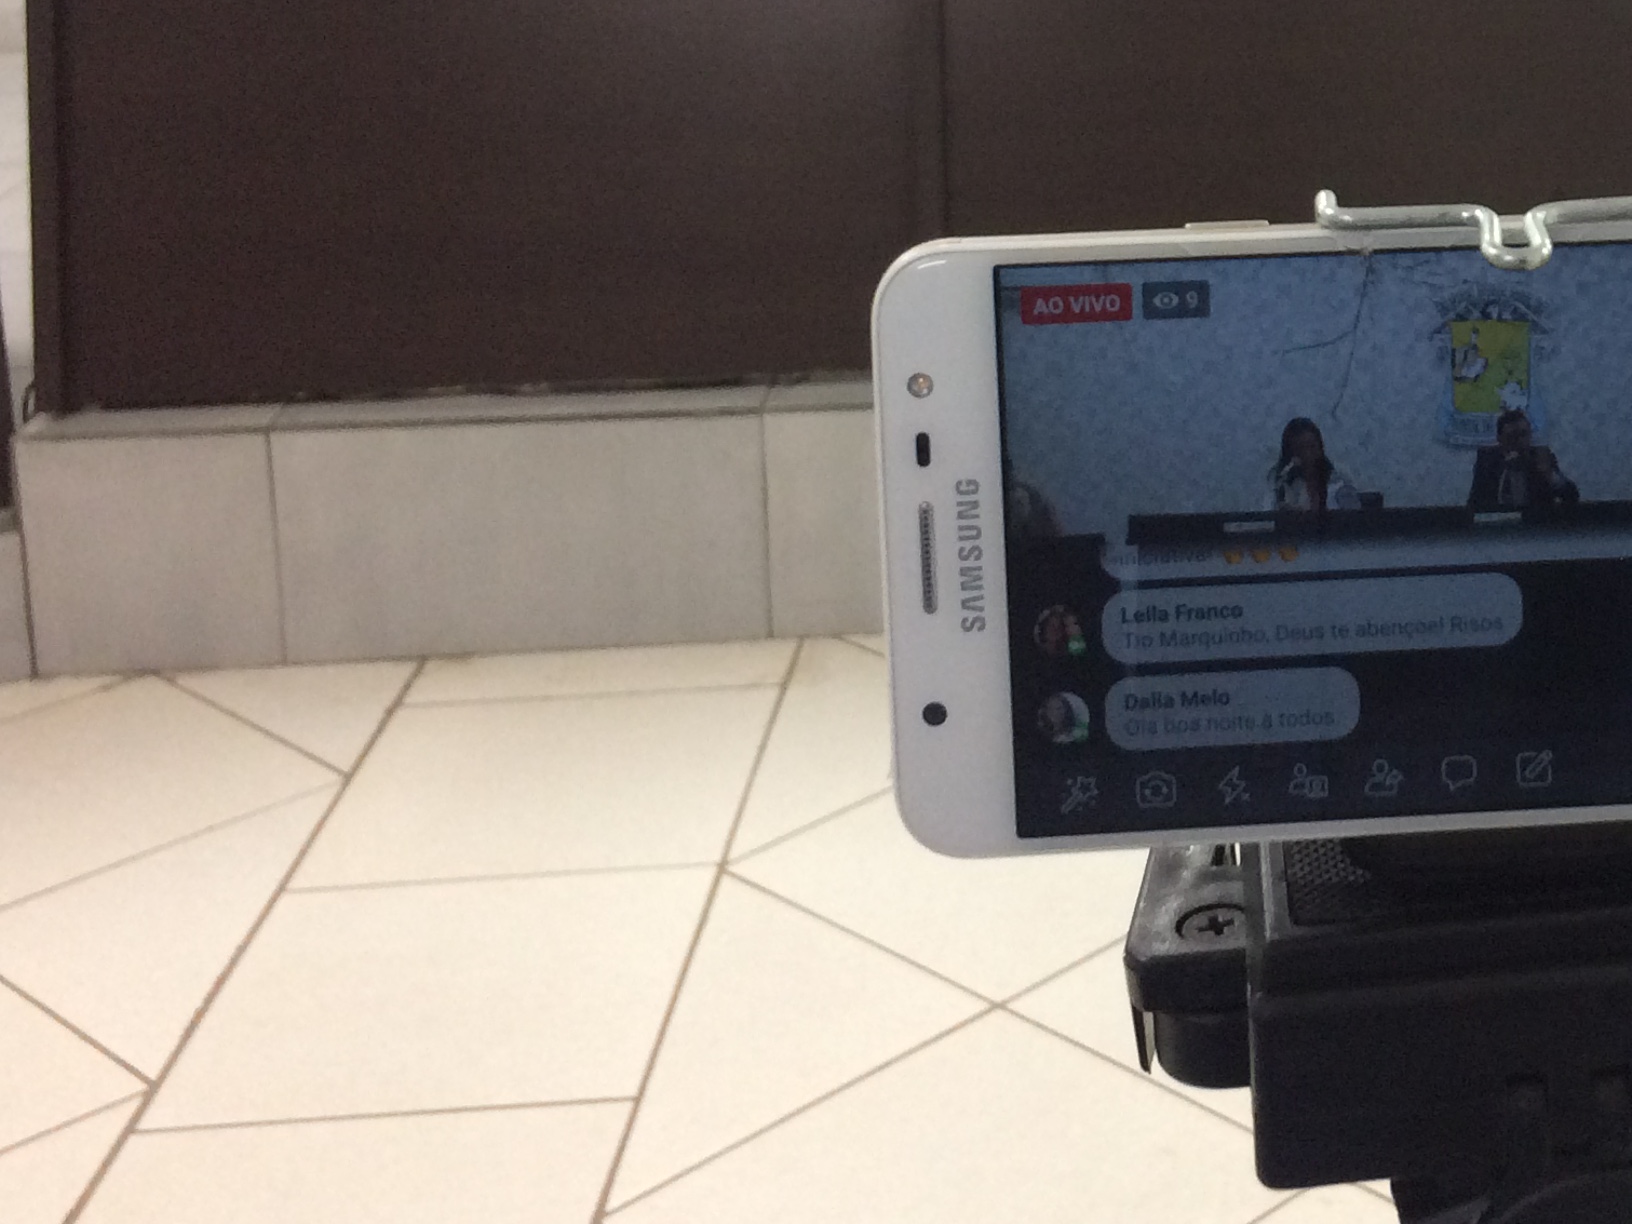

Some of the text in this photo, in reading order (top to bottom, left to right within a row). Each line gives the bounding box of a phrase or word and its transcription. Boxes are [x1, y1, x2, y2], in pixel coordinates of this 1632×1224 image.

[1033, 294, 1121, 316] AO VIVO
[1186, 291, 1198, 309] 9
[955, 478, 986, 633] SAMSUNG
[1175, 604, 1243, 623] Franco
[1276, 624, 1325, 642] Deus
[1331, 624, 1349, 640] te
[1181, 689, 1230, 708] Melo
[1279, 709, 1335, 727] todos
